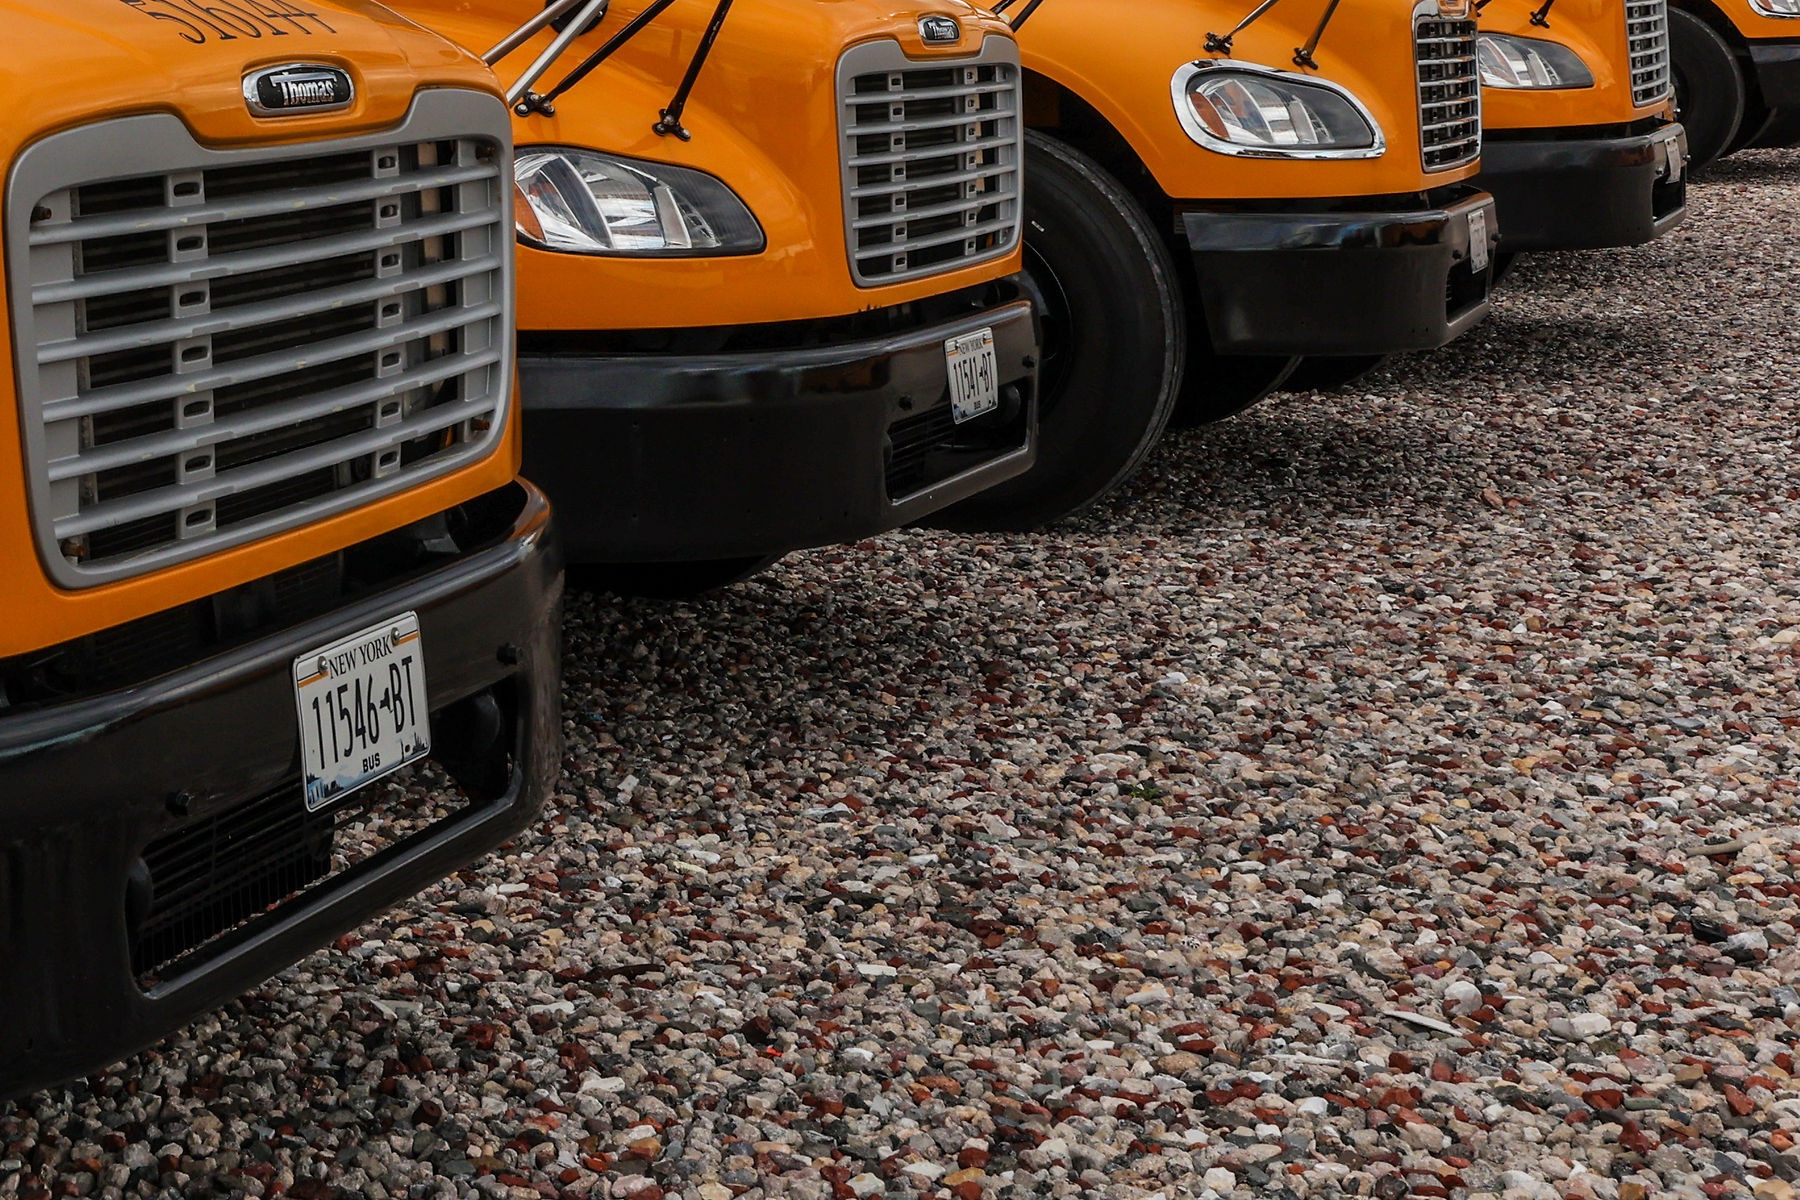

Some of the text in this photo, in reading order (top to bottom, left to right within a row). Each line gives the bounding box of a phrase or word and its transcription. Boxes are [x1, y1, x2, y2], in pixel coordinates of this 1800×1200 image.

[269, 71, 338, 106] Thomas
[328, 634, 393, 680] NEW YORK
[362, 752, 381, 774] BUS
